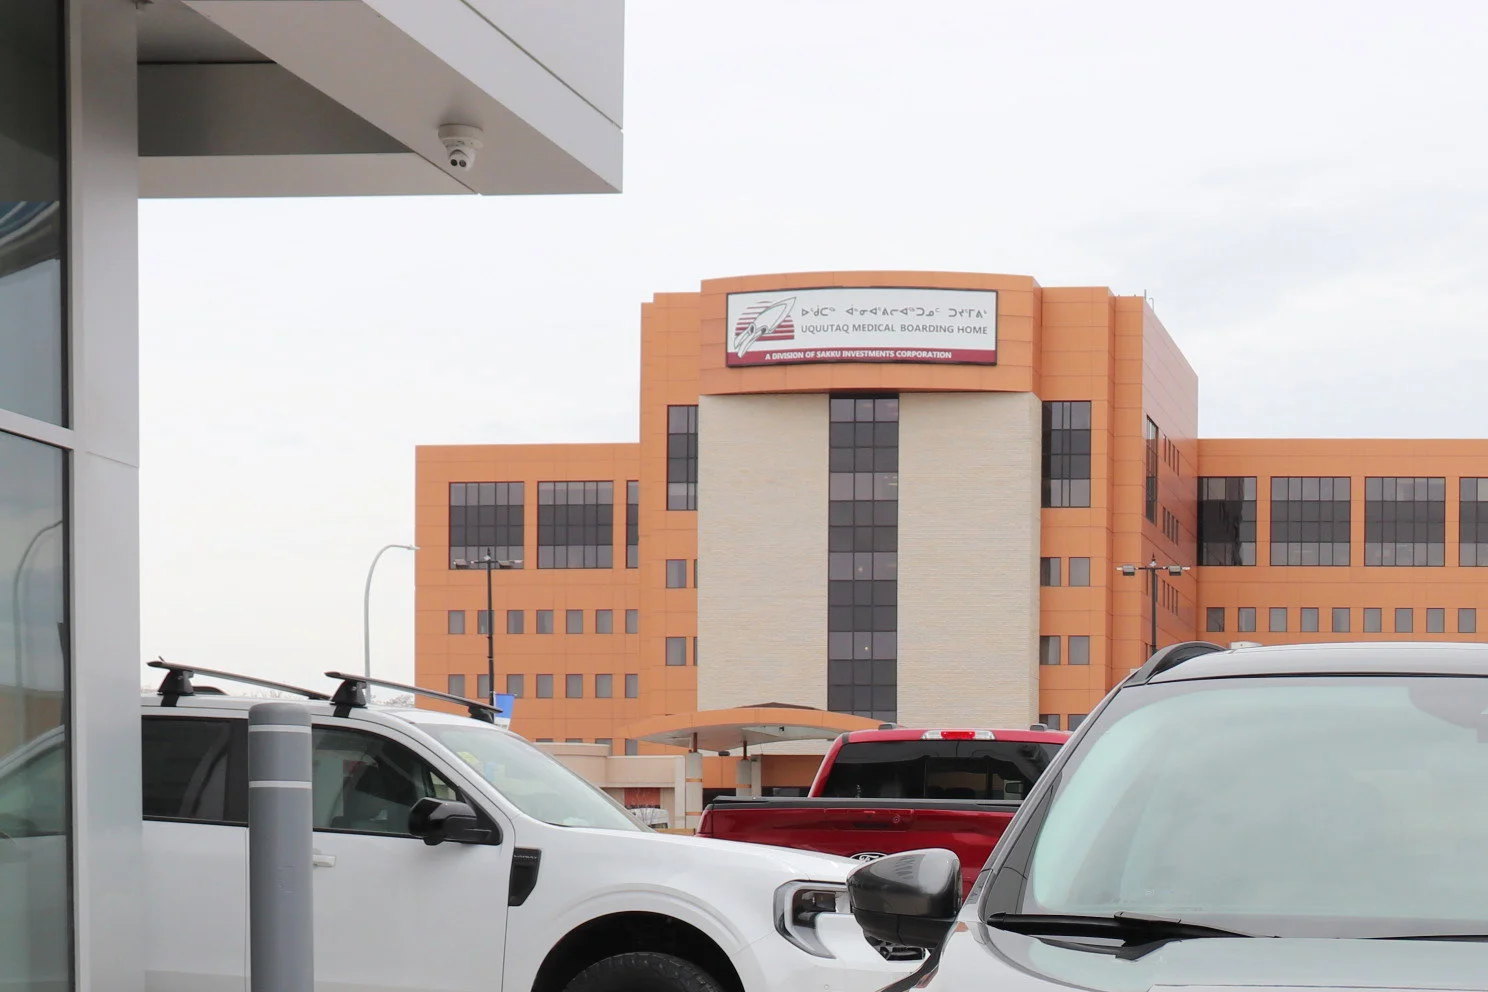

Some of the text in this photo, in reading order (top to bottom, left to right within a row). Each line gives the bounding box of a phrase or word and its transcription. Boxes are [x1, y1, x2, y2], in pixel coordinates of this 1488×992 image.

[801, 324, 988, 334] UQUUTAQ MEDICAL BOARDING HOME
[771, 351, 804, 360] DIVISION
[816, 350, 841, 358] SAKKU
[842, 350, 895, 358] INVESTMENTS
[896, 350, 952, 359] CORPORATION
